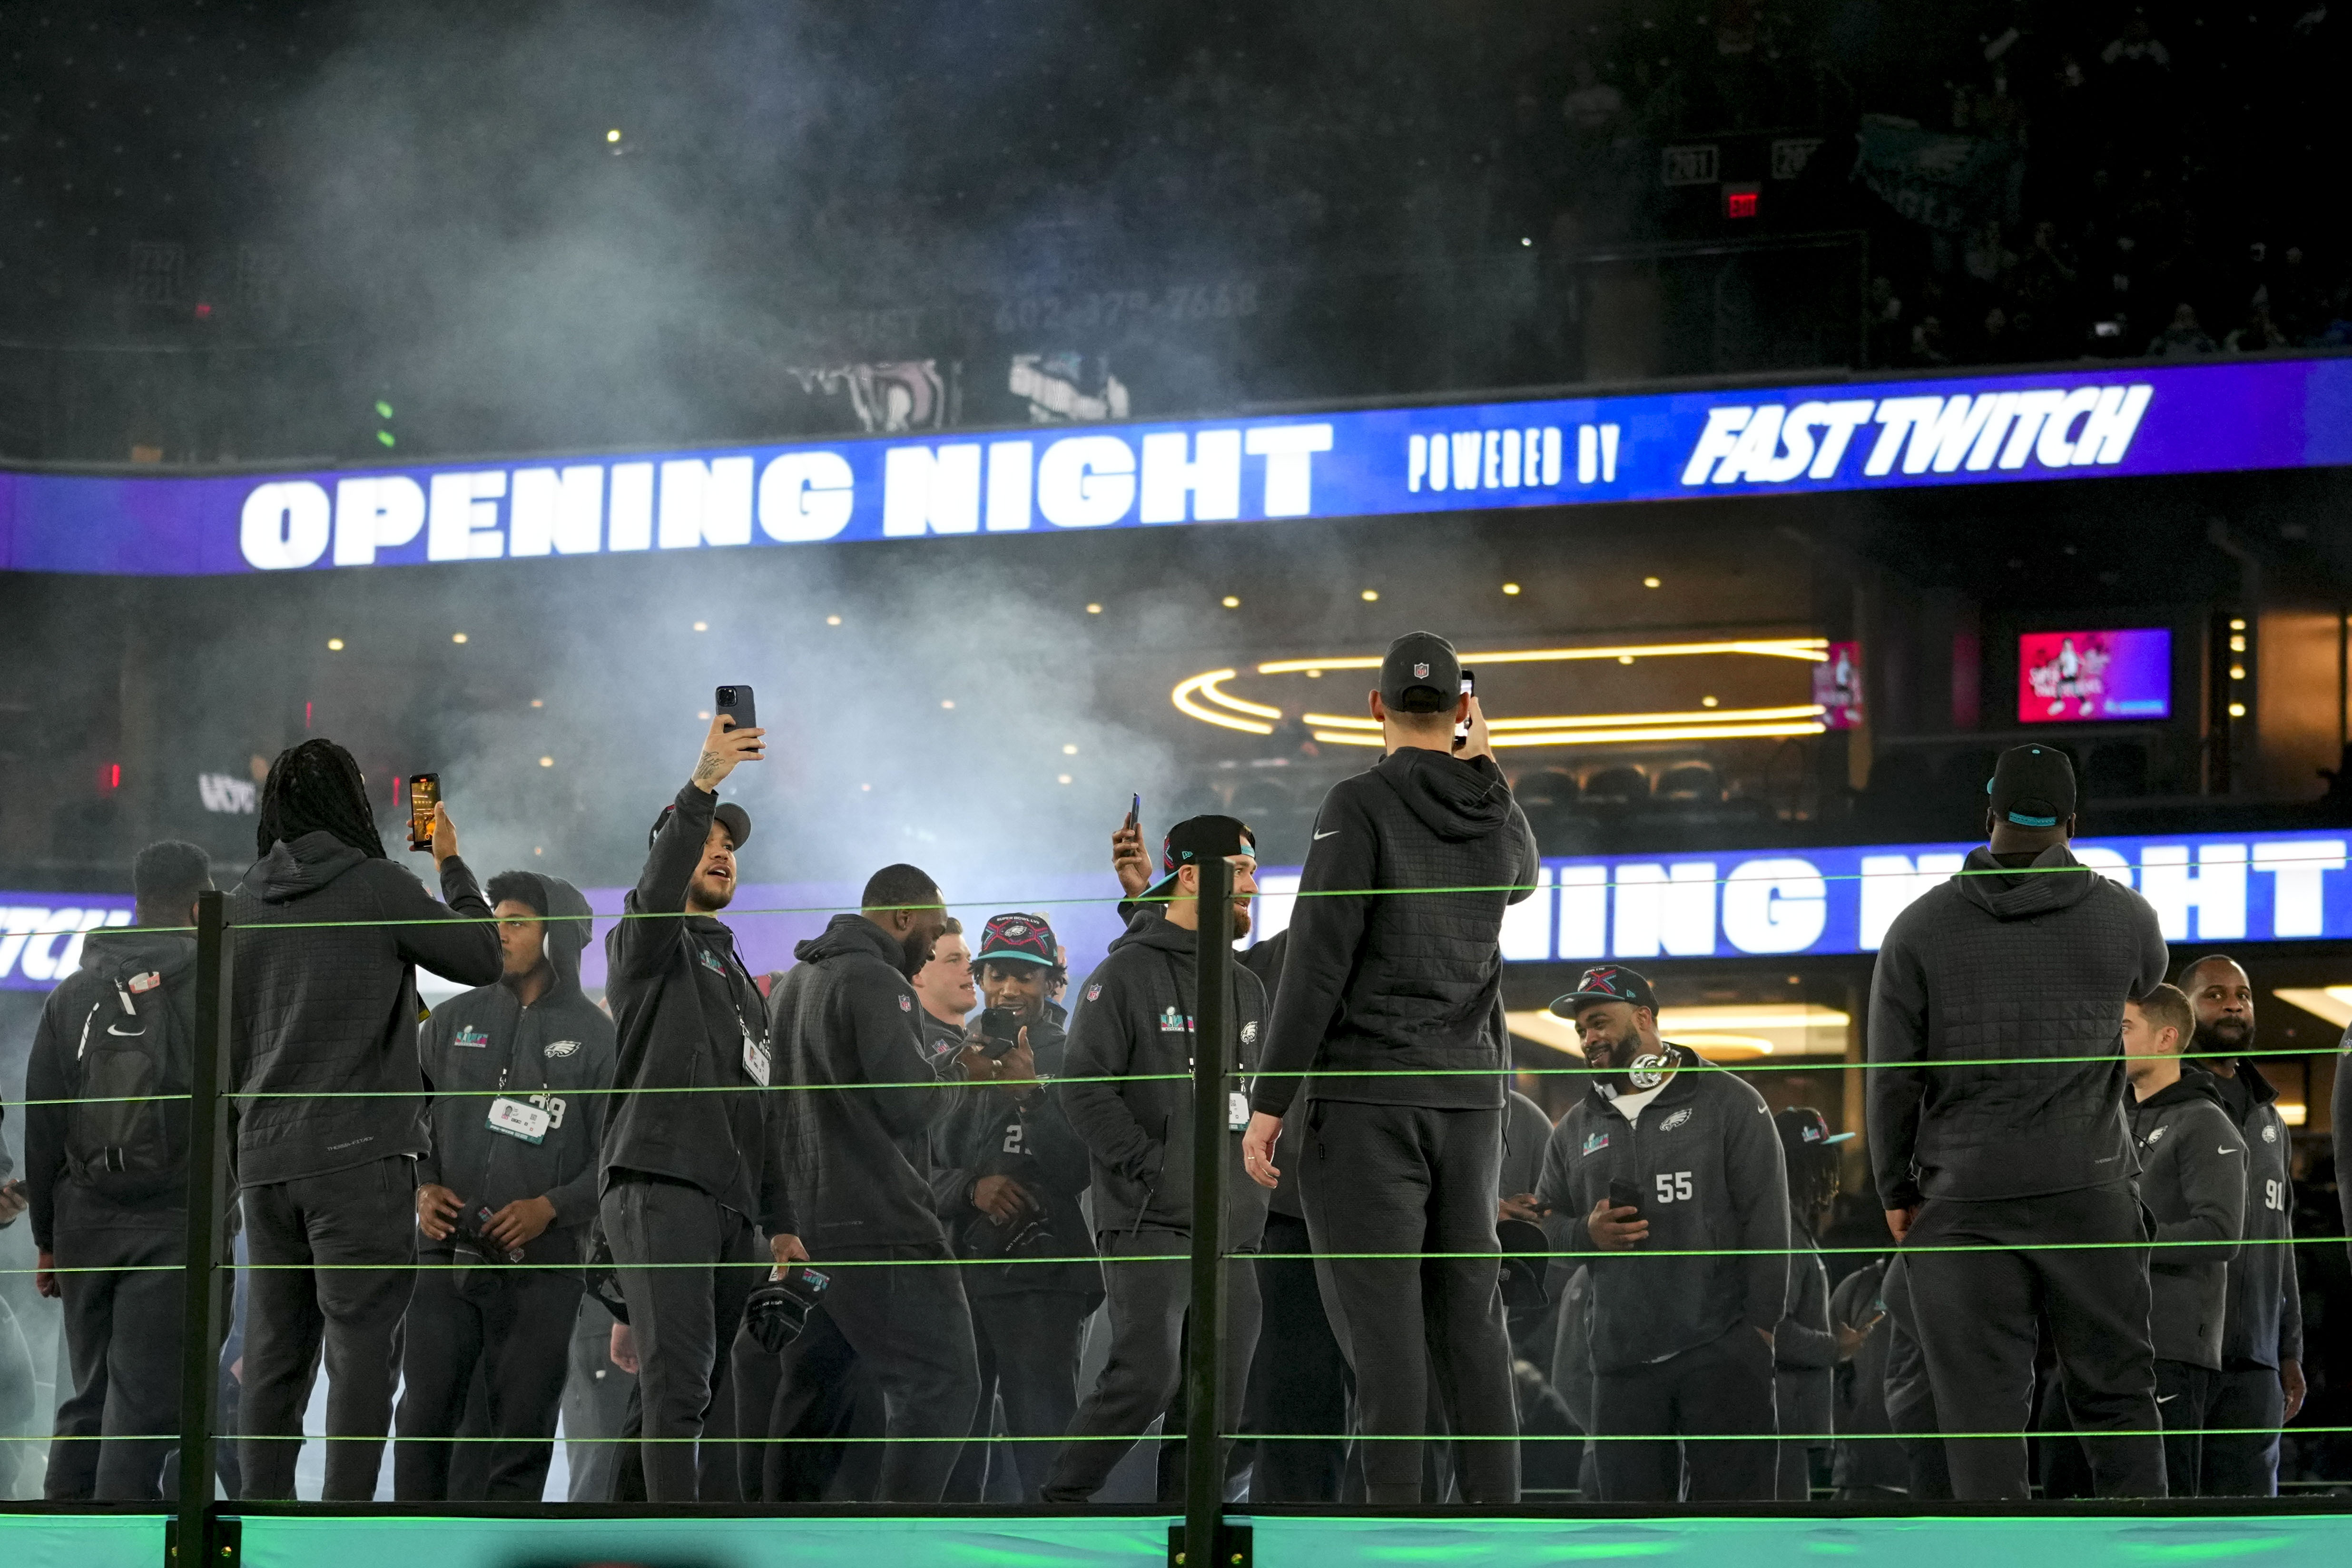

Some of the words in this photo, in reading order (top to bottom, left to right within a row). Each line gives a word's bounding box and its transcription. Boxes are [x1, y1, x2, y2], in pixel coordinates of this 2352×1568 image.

[240, 450, 855, 572] OPENING
[882, 422, 1334, 538] NIGHT
[1407, 426, 1562, 492] POWERED
[1577, 424, 1620, 484] BY
[1681, 399, 1876, 485] FAST
[1864, 384, 2154, 476] TWITCH
[1860, 840, 2347, 951] NHT
[1656, 1171, 1693, 1204] 55
[2264, 1178, 2283, 1211] 91
